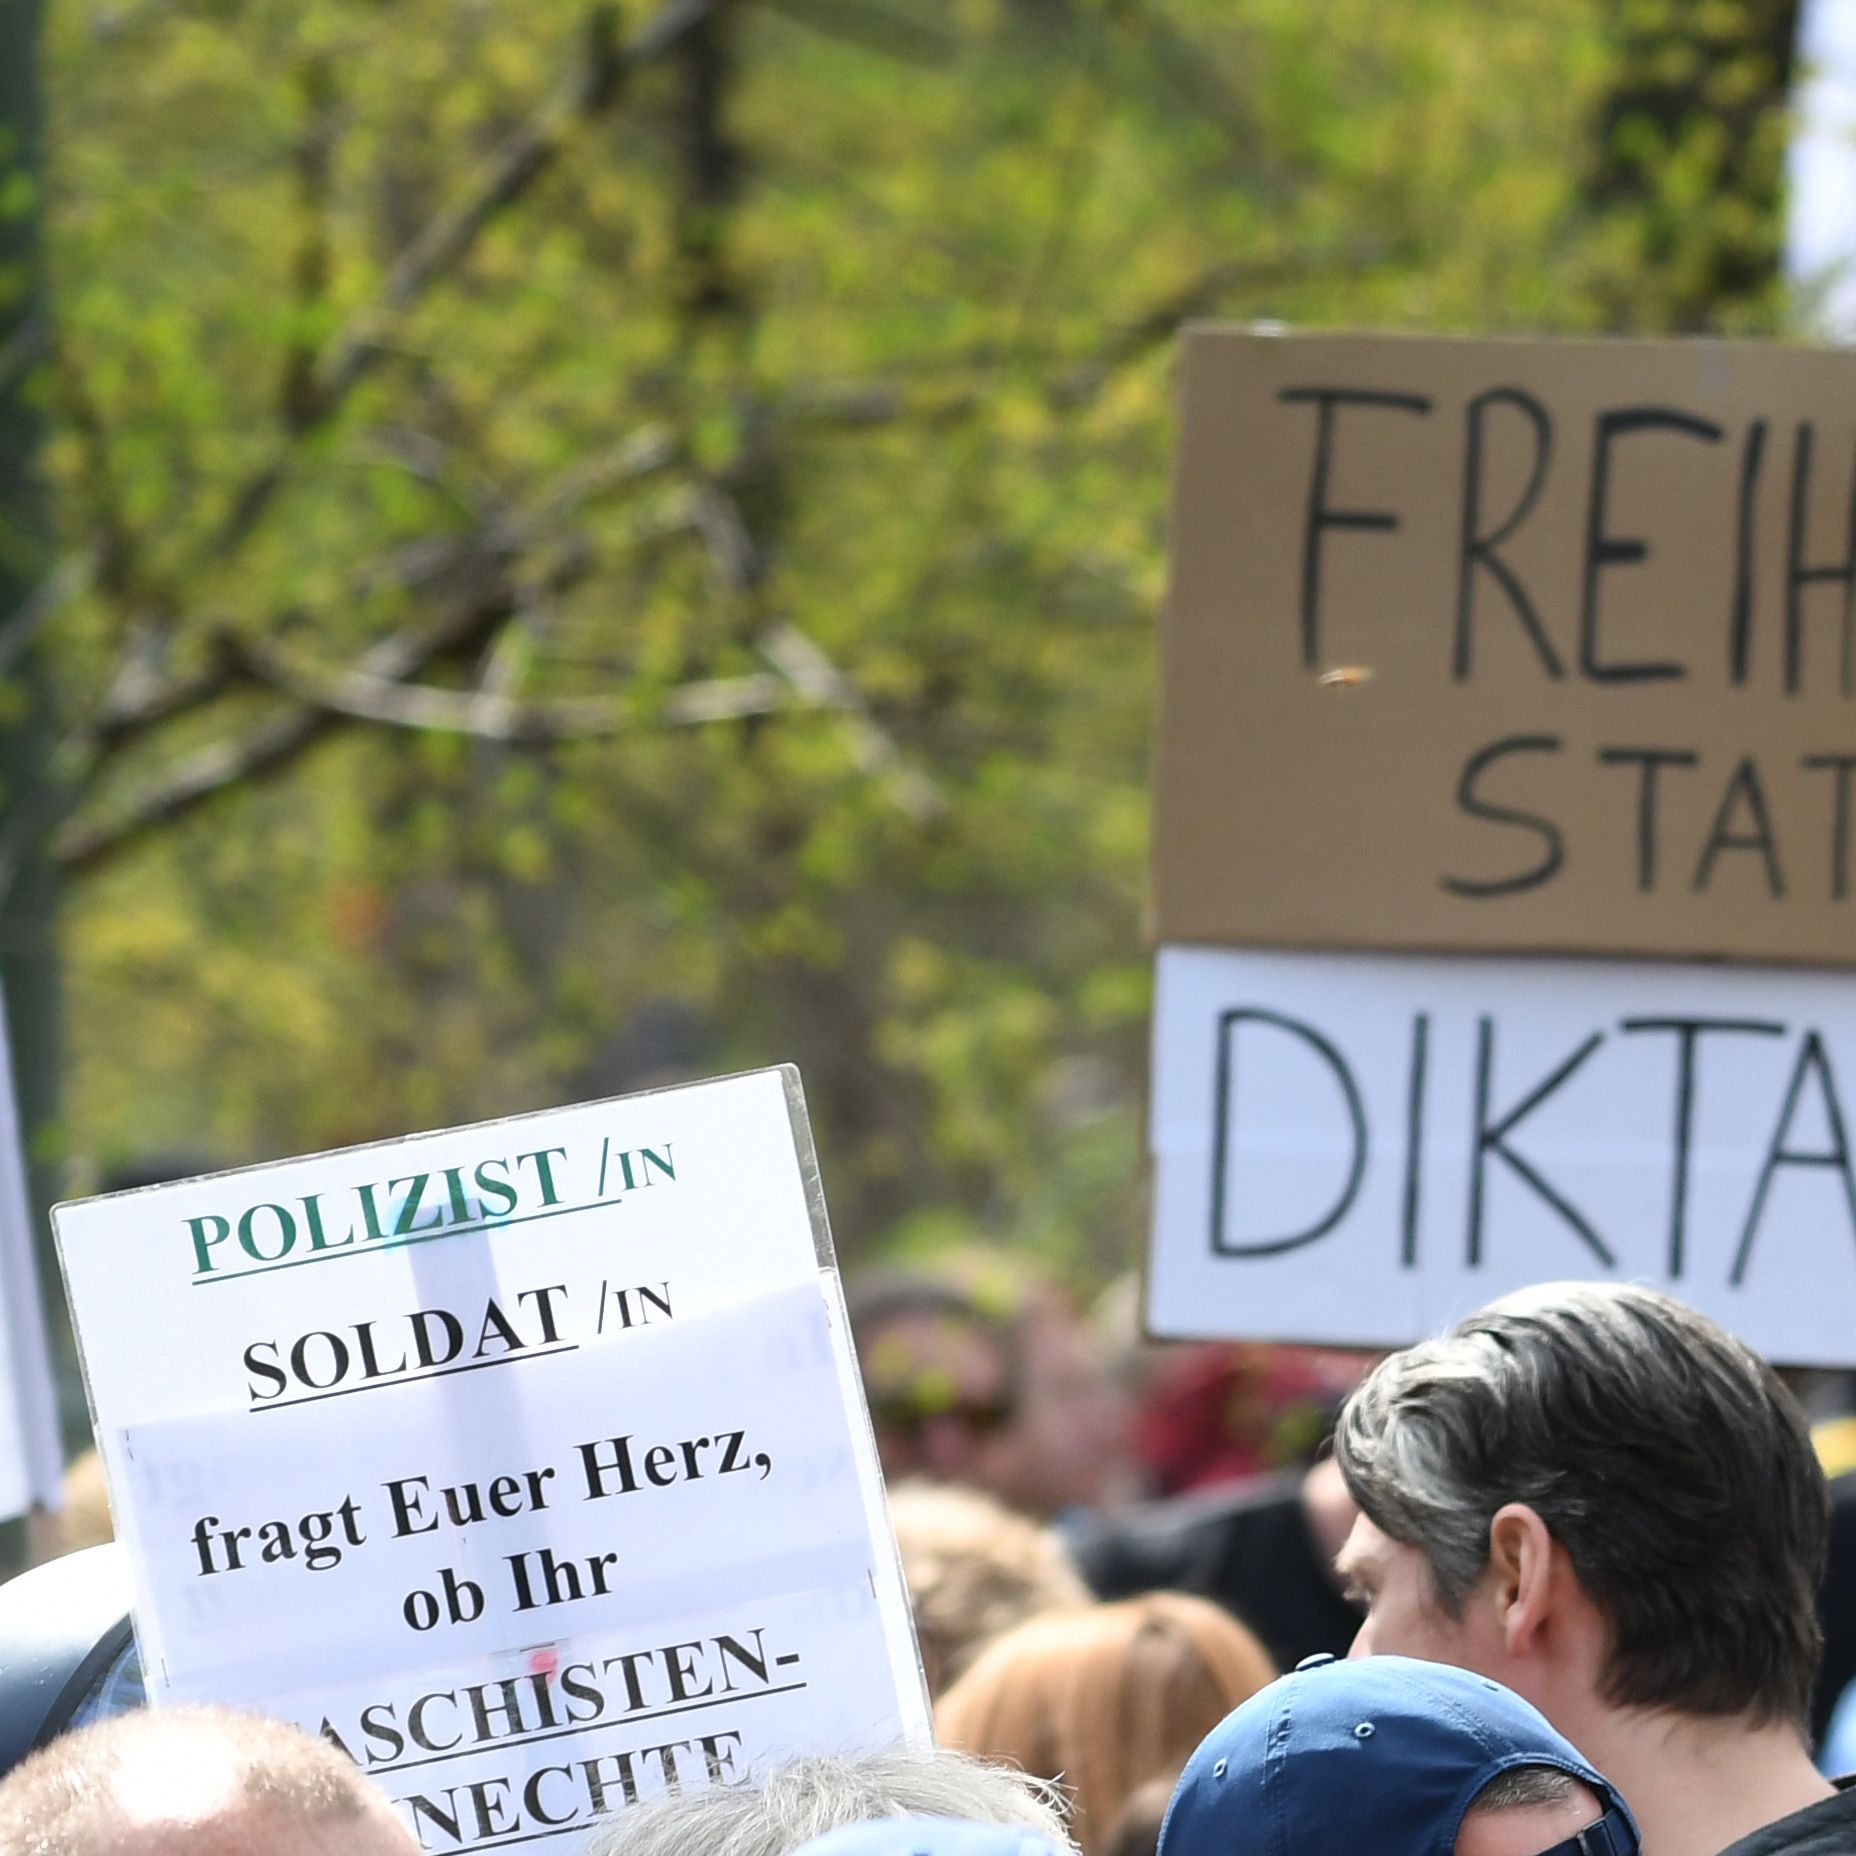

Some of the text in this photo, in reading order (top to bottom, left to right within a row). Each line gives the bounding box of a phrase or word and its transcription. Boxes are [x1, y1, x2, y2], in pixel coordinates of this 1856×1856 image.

[181, 1146, 568, 1277] POLIZIST
[243, 1284, 569, 1402] SOLDAT
[190, 1430, 773, 1577] fragt Euer Herz,
[402, 1548, 619, 1632] ob Ihr
[316, 1627, 801, 1768] ASCHISTEN-
[391, 1730, 743, 1852] NECHTE
